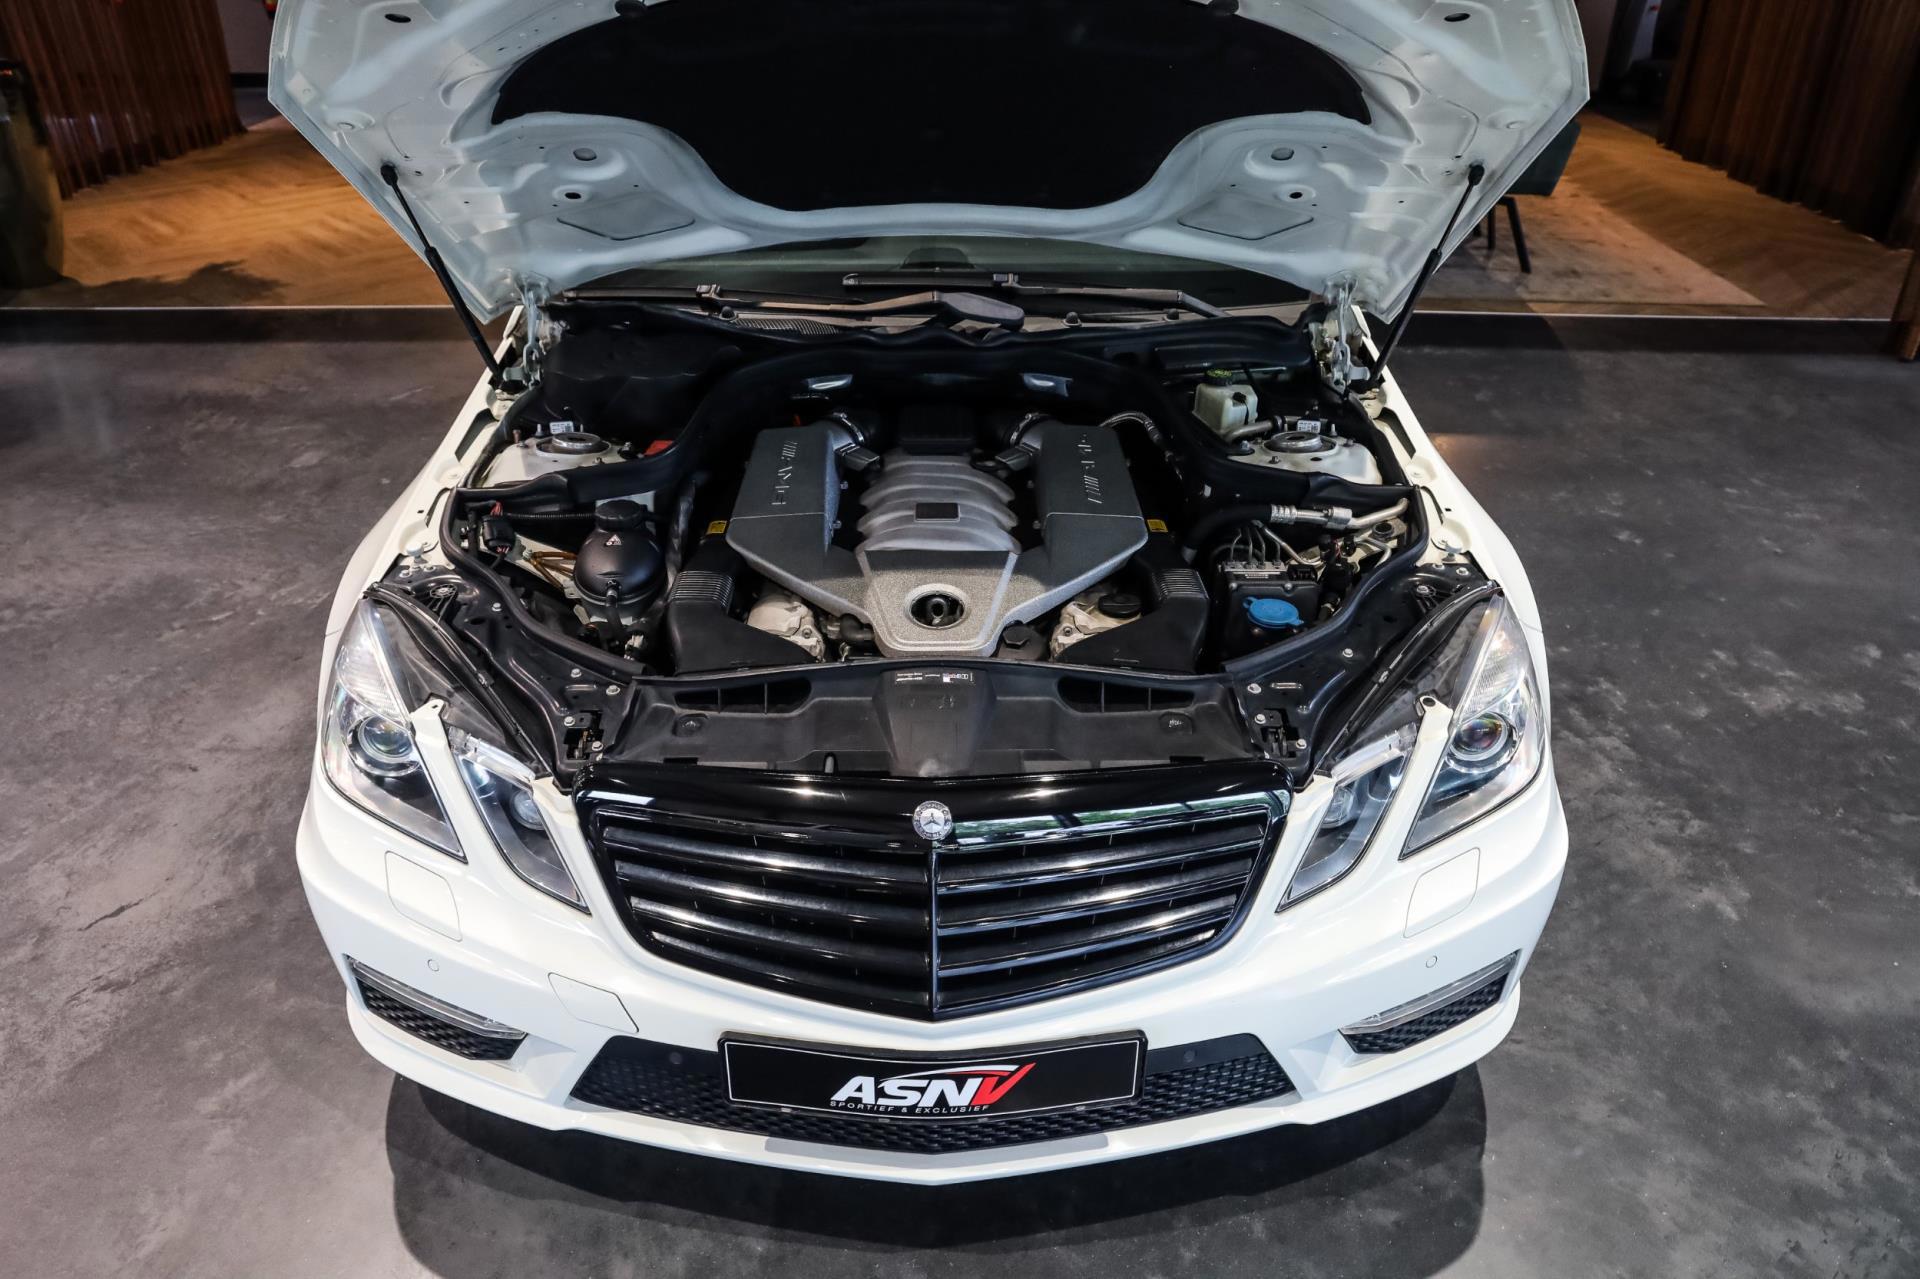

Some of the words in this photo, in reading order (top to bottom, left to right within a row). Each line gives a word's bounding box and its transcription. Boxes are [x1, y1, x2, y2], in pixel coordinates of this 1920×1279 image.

[830, 1101, 895, 1112] SPORTIEF
[901, 1105, 908, 1113] &
[915, 1104, 989, 1114] EXCLUSIEF
